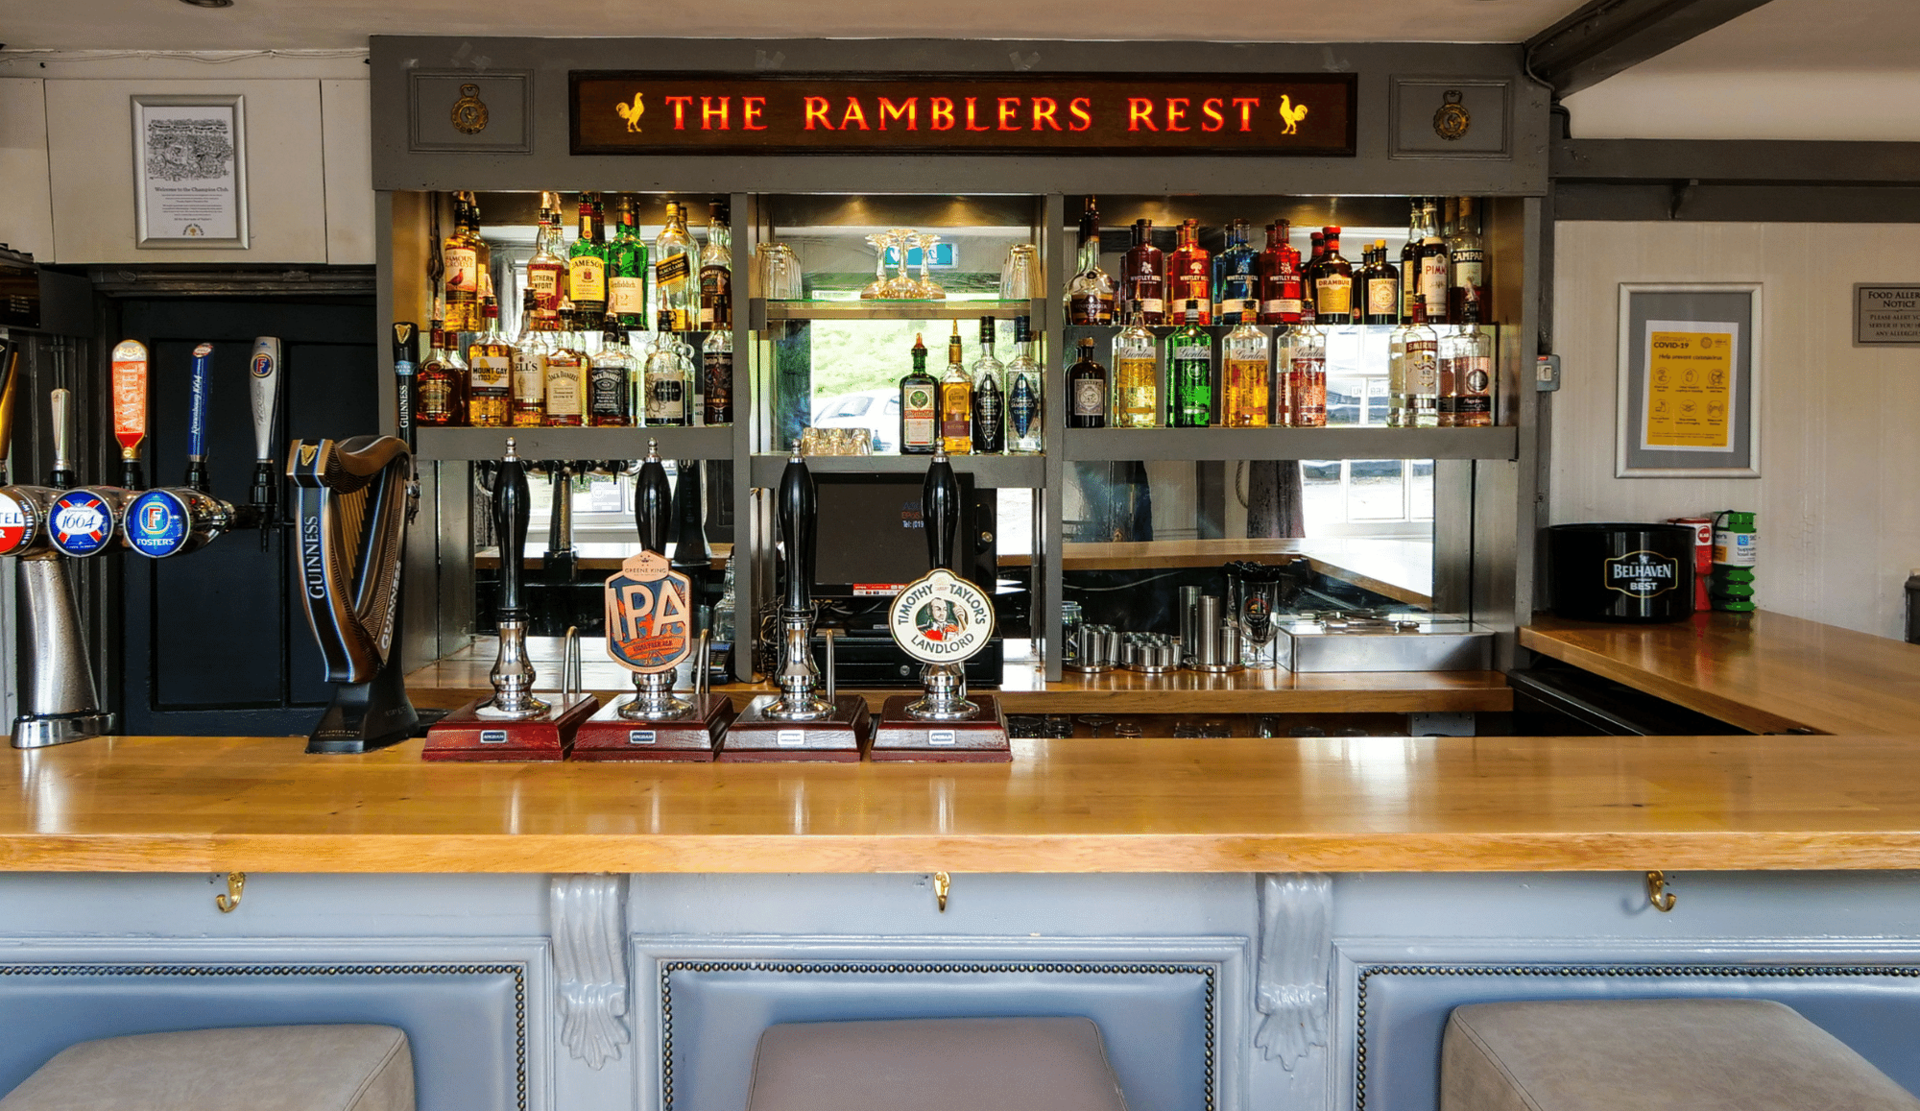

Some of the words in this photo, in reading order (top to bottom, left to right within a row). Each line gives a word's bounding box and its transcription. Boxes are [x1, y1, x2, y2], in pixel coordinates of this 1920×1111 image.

[665, 96, 768, 131] THE
[802, 96, 1093, 131] RAMBLERS
[1127, 96, 1260, 131] REST
[572, 258, 604, 271] JAMESON
[256, 358, 267, 374] F
[515, 361, 538, 372] ELL'S
[548, 372, 560, 381] JACK
[122, 365, 139, 427] AMSTEL
[400, 385, 408, 428] GUINNESS
[62, 514, 96, 528] 1664
[147, 506, 162, 530] F
[304, 516, 326, 599] GUINNESS
[1614, 564, 1672, 578] BELHAVEN
[1630, 582, 1658, 590] BEST
[381, 560, 401, 649] GUINNESS
[608, 580, 686, 641] IPA
[898, 584, 933, 625] TIMOTHY
[950, 584, 986, 625] TAYLOR'S
[911, 632, 975, 654] LANDLORD
